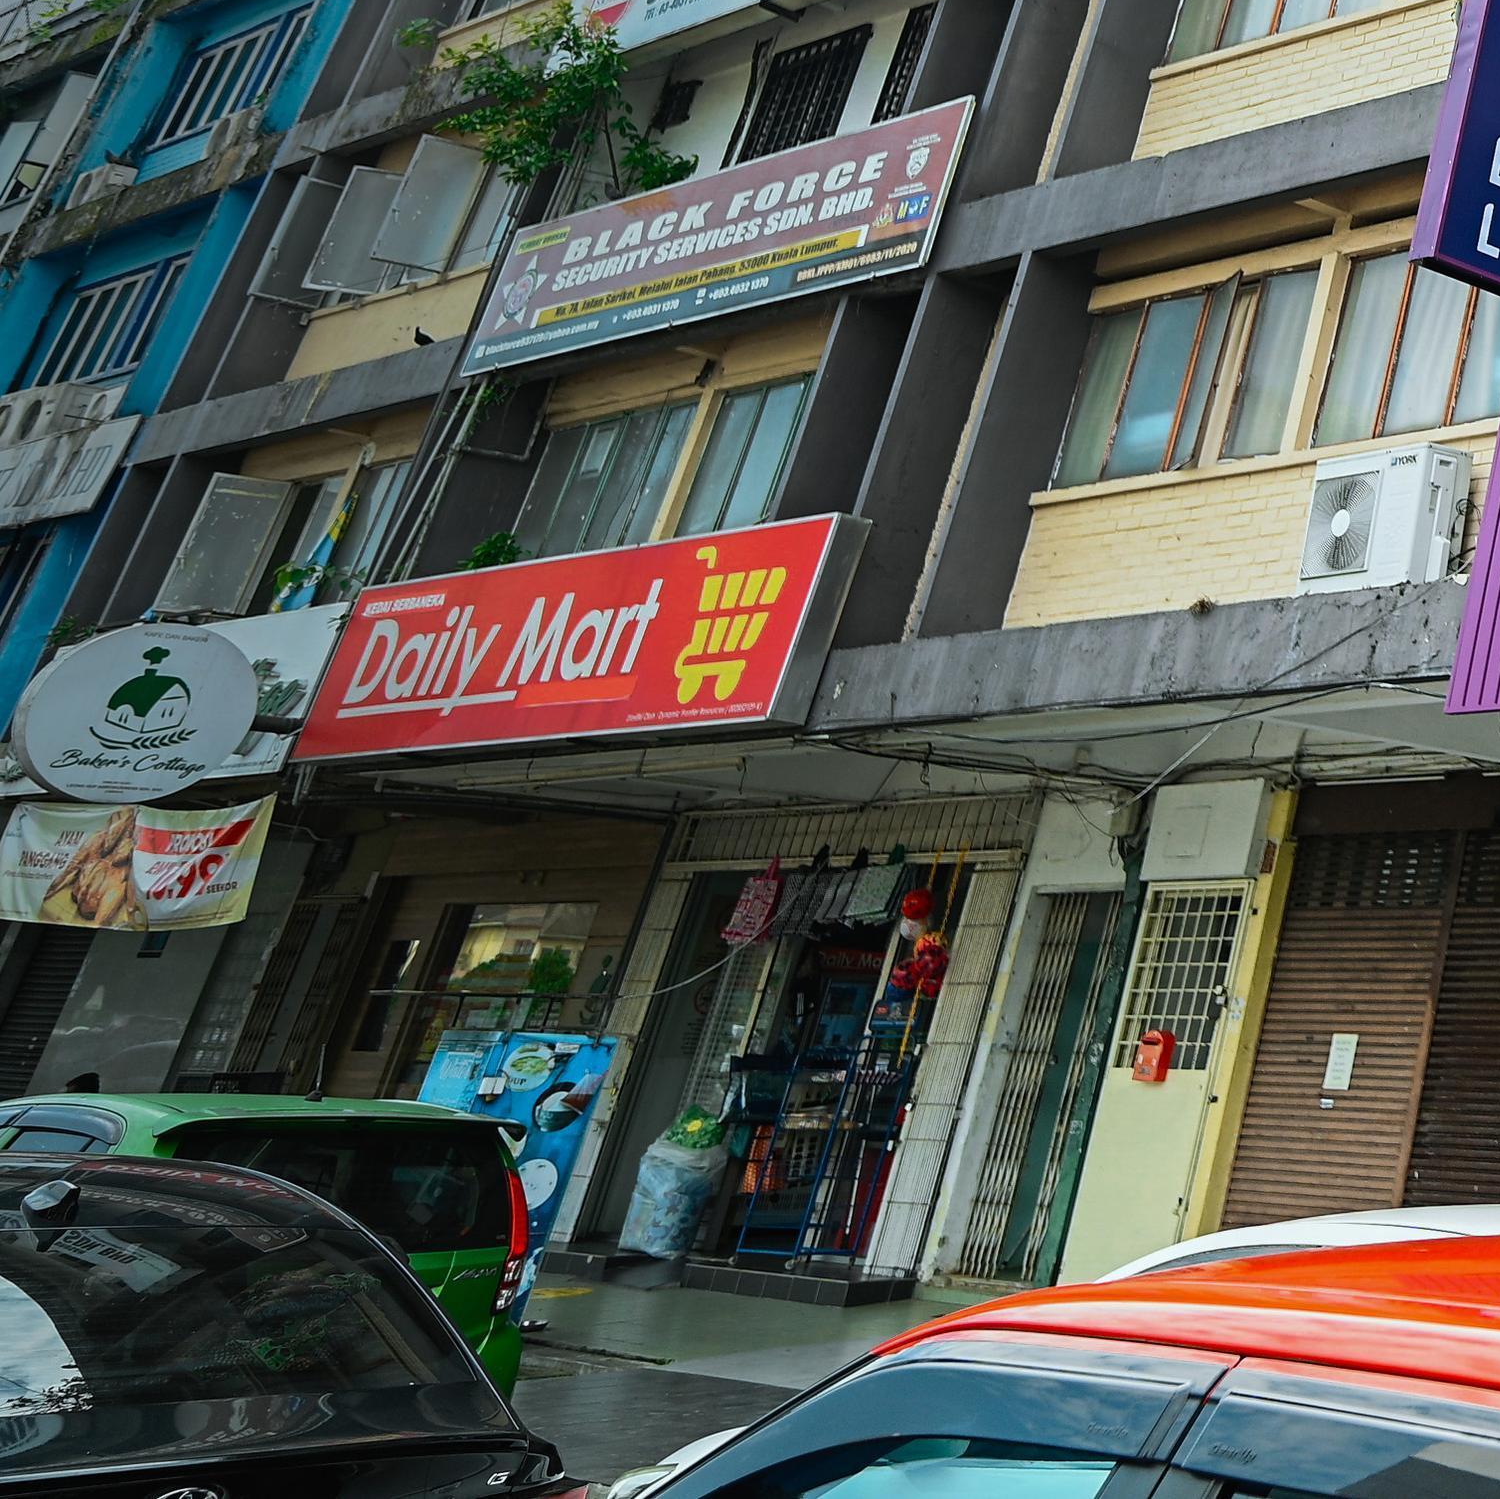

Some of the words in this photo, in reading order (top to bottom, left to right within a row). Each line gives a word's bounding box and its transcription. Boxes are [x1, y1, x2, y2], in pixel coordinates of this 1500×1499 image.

[552, 246, 655, 292] SECURITY
[654, 216, 762, 265] SERVICES
[562, 201, 714, 265] BLACK
[726, 151, 889, 220] FORCE
[342, 604, 502, 716] Daily
[496, 578, 665, 688] Mart
[50, 749, 131, 770] Baker's
[133, 754, 206, 779] Cottage
